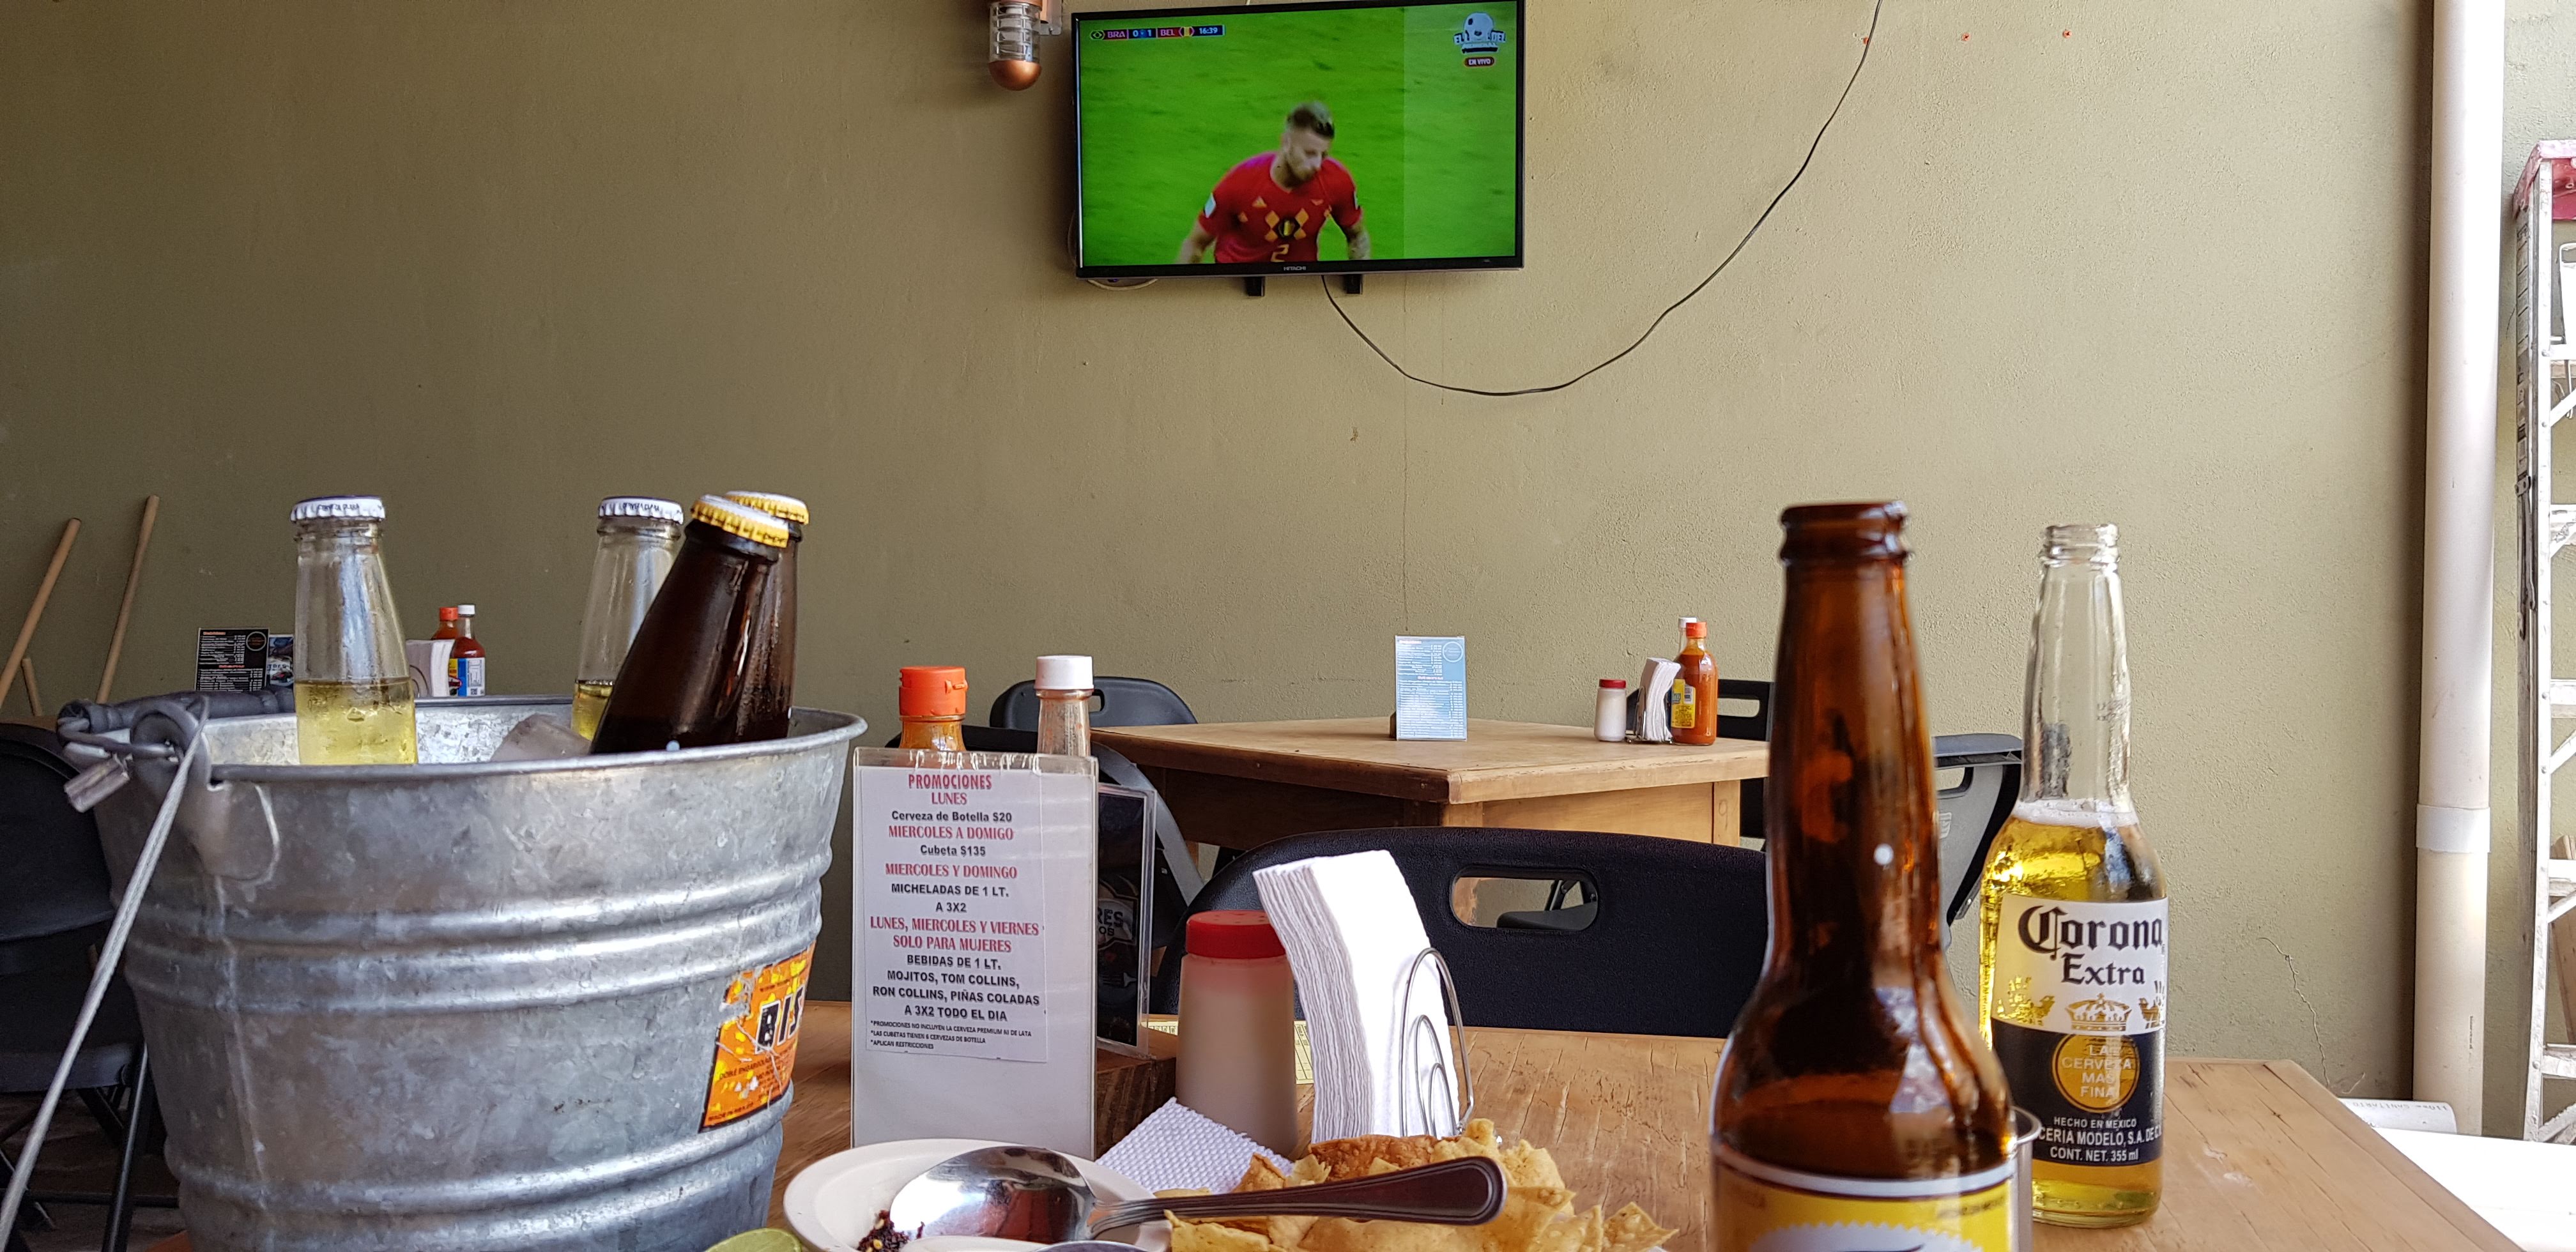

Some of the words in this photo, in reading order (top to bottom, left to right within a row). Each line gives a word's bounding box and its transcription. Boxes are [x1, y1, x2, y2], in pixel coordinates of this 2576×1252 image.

[908, 774, 992, 790] PROMOCIONES
[931, 792, 967, 805] LUNES
[892, 811, 933, 821] Cerveza
[936, 811, 949, 821] de
[953, 812, 990, 822] Botella
[889, 825, 953, 839] MIERCOLES
[956, 827, 964, 839] A
[967, 827, 1014, 841] DOMIGO
[921, 845, 957, 856] Cubeta
[960, 846, 986, 857] $135
[885, 863, 949, 877] MIERCOLES
[953, 865, 960, 878] Y
[963, 866, 1018, 879] DOMINGO
[891, 883, 961, 895] MICHELADAS
[965, 886, 979, 896] DE
[982, 887, 988, 896] 1
[992, 887, 1009, 897] LT.
[936, 902, 943, 912] A
[946, 903, 967, 913] 3X2
[870, 916, 908, 932] LUNES,
[912, 918, 976, 933] MIERCOLES
[980, 921, 988, 934] Y
[991, 922, 1039, 936] VIERNES
[2018, 905, 2162, 961] Corona
[893, 935, 923, 949] SOLO
[926, 936, 956, 950] PARA
[960, 938, 1012, 952] MUJERES
[907, 954, 954, 968] BEBIDAS
[957, 958, 972, 968] DE
[975, 959, 980, 970] 1
[984, 959, 1002, 970] LT.
[2061, 952, 2145, 985] Extra
[887, 970, 939, 985] MOJITOS,
[941, 973, 965, 984] TOM
[969, 975, 1020, 989] COLLINS,
[873, 986, 896, 997] RON
[898, 988, 947, 1002] COLLINS,
[951, 989, 983, 1003] PIÑAS
[987, 993, 1040, 1005] COLADAS
[905, 1005, 912, 1016] A
[915, 1006, 935, 1018] 3X2
[937, 1007, 967, 1019] TODO
[971, 1009, 985, 1020] EL
[988, 1010, 1008, 1021] DIA
[2089, 1044, 2108, 1056] LA
[2062, 1057, 2132, 1070] CERVEZA
[2082, 1073, 2115, 1084] MAS
[2080, 1086, 2116, 1097] FINA
[2053, 1117, 2088, 1128] HECHO
[2090, 1120, 2104, 1129] EN
[2106, 1117, 2137, 1129] MEXICO
[2076, 1131, 2126, 1148] MODELO,
[2128, 1129, 2145, 1145] S.A.
[2146, 1127, 2154, 1141] DE
[2050, 1146, 2083, 1161] CONT.
[2085, 1149, 2108, 1162] NET.
[2111, 1149, 2128, 1162] 355
[2128, 1148, 2139, 1161] ml
